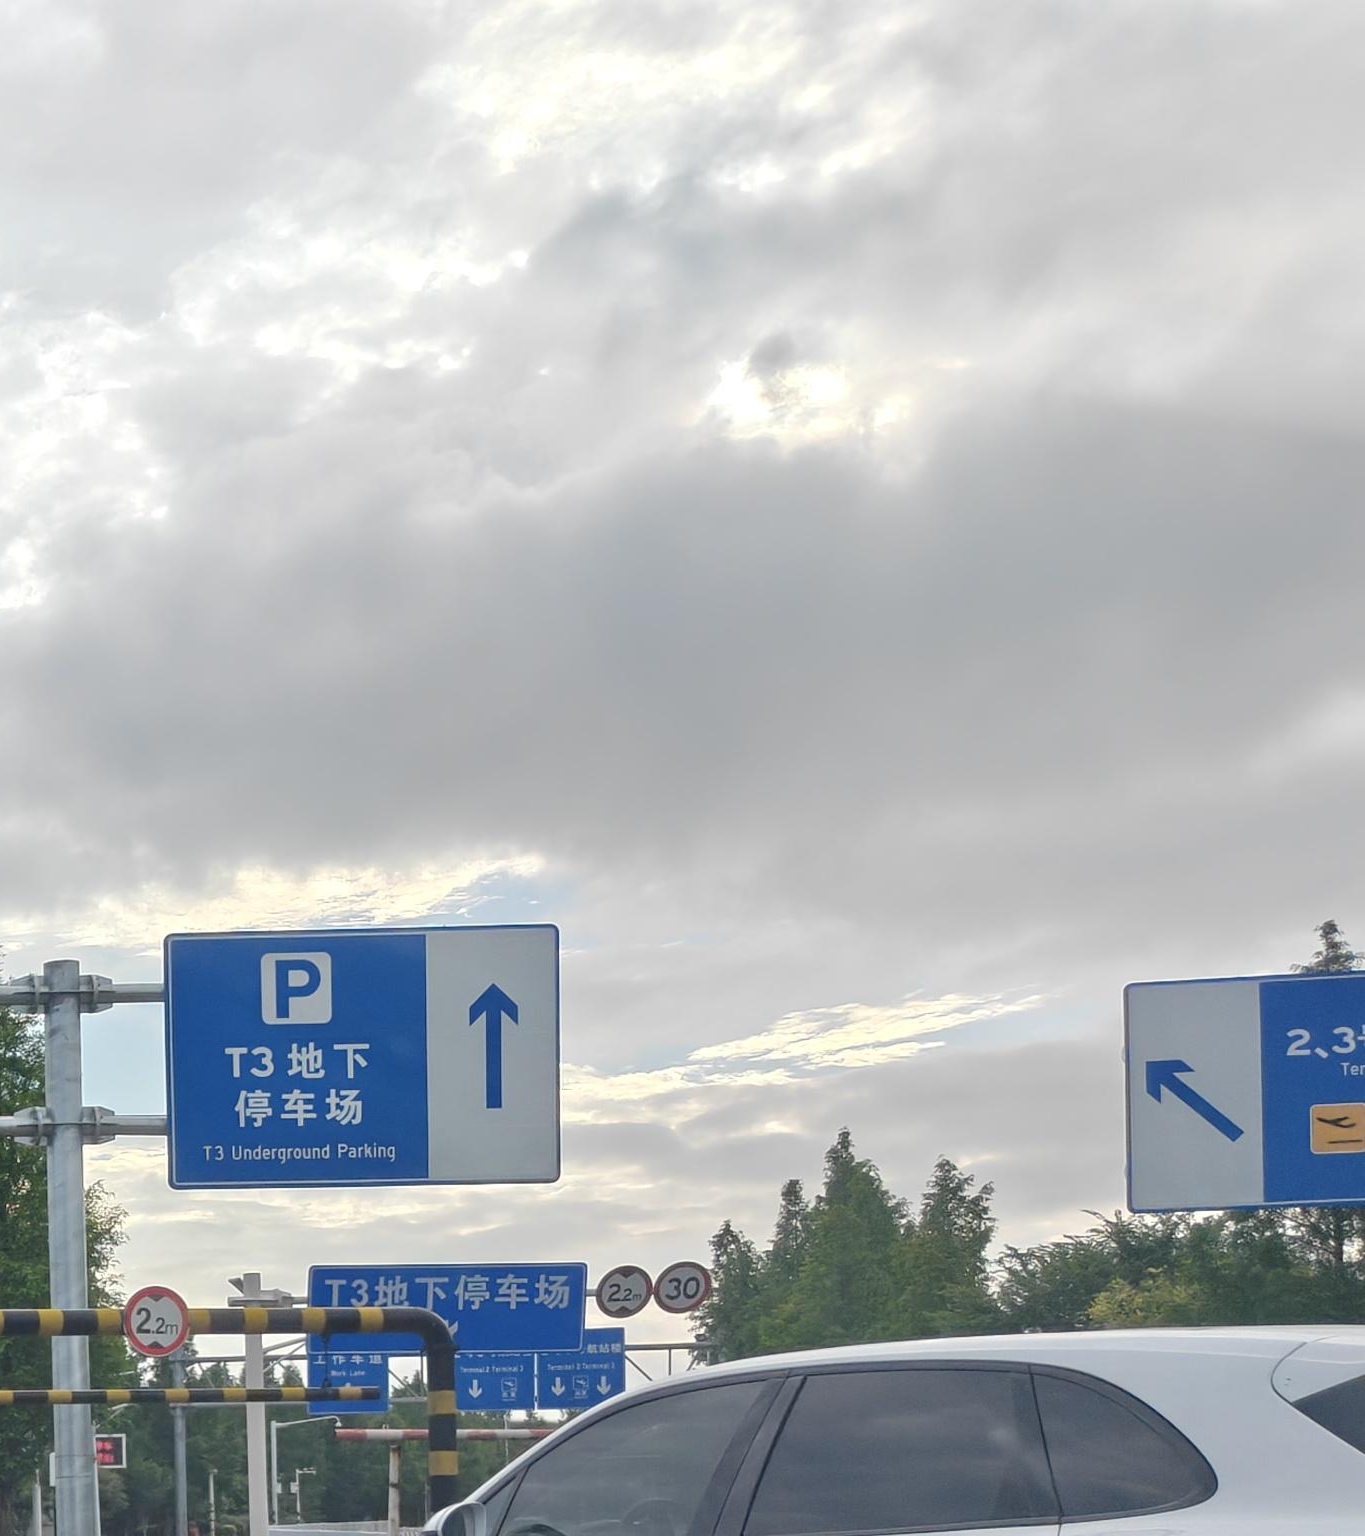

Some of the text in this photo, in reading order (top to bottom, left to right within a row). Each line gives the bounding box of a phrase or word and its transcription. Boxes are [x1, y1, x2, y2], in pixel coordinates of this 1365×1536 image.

[275, 959, 322, 1019] P
[1286, 1025, 1365, 1058] 2、3
[224, 1042, 371, 1080] T3地下
[234, 1088, 364, 1128] 停车场
[203, 1142, 397, 1164] T3 Underground Parking
[324, 1274, 570, 1311] T3地下停车场
[665, 1276, 701, 1300] 30
[135, 1307, 179, 1335] 2.2m
